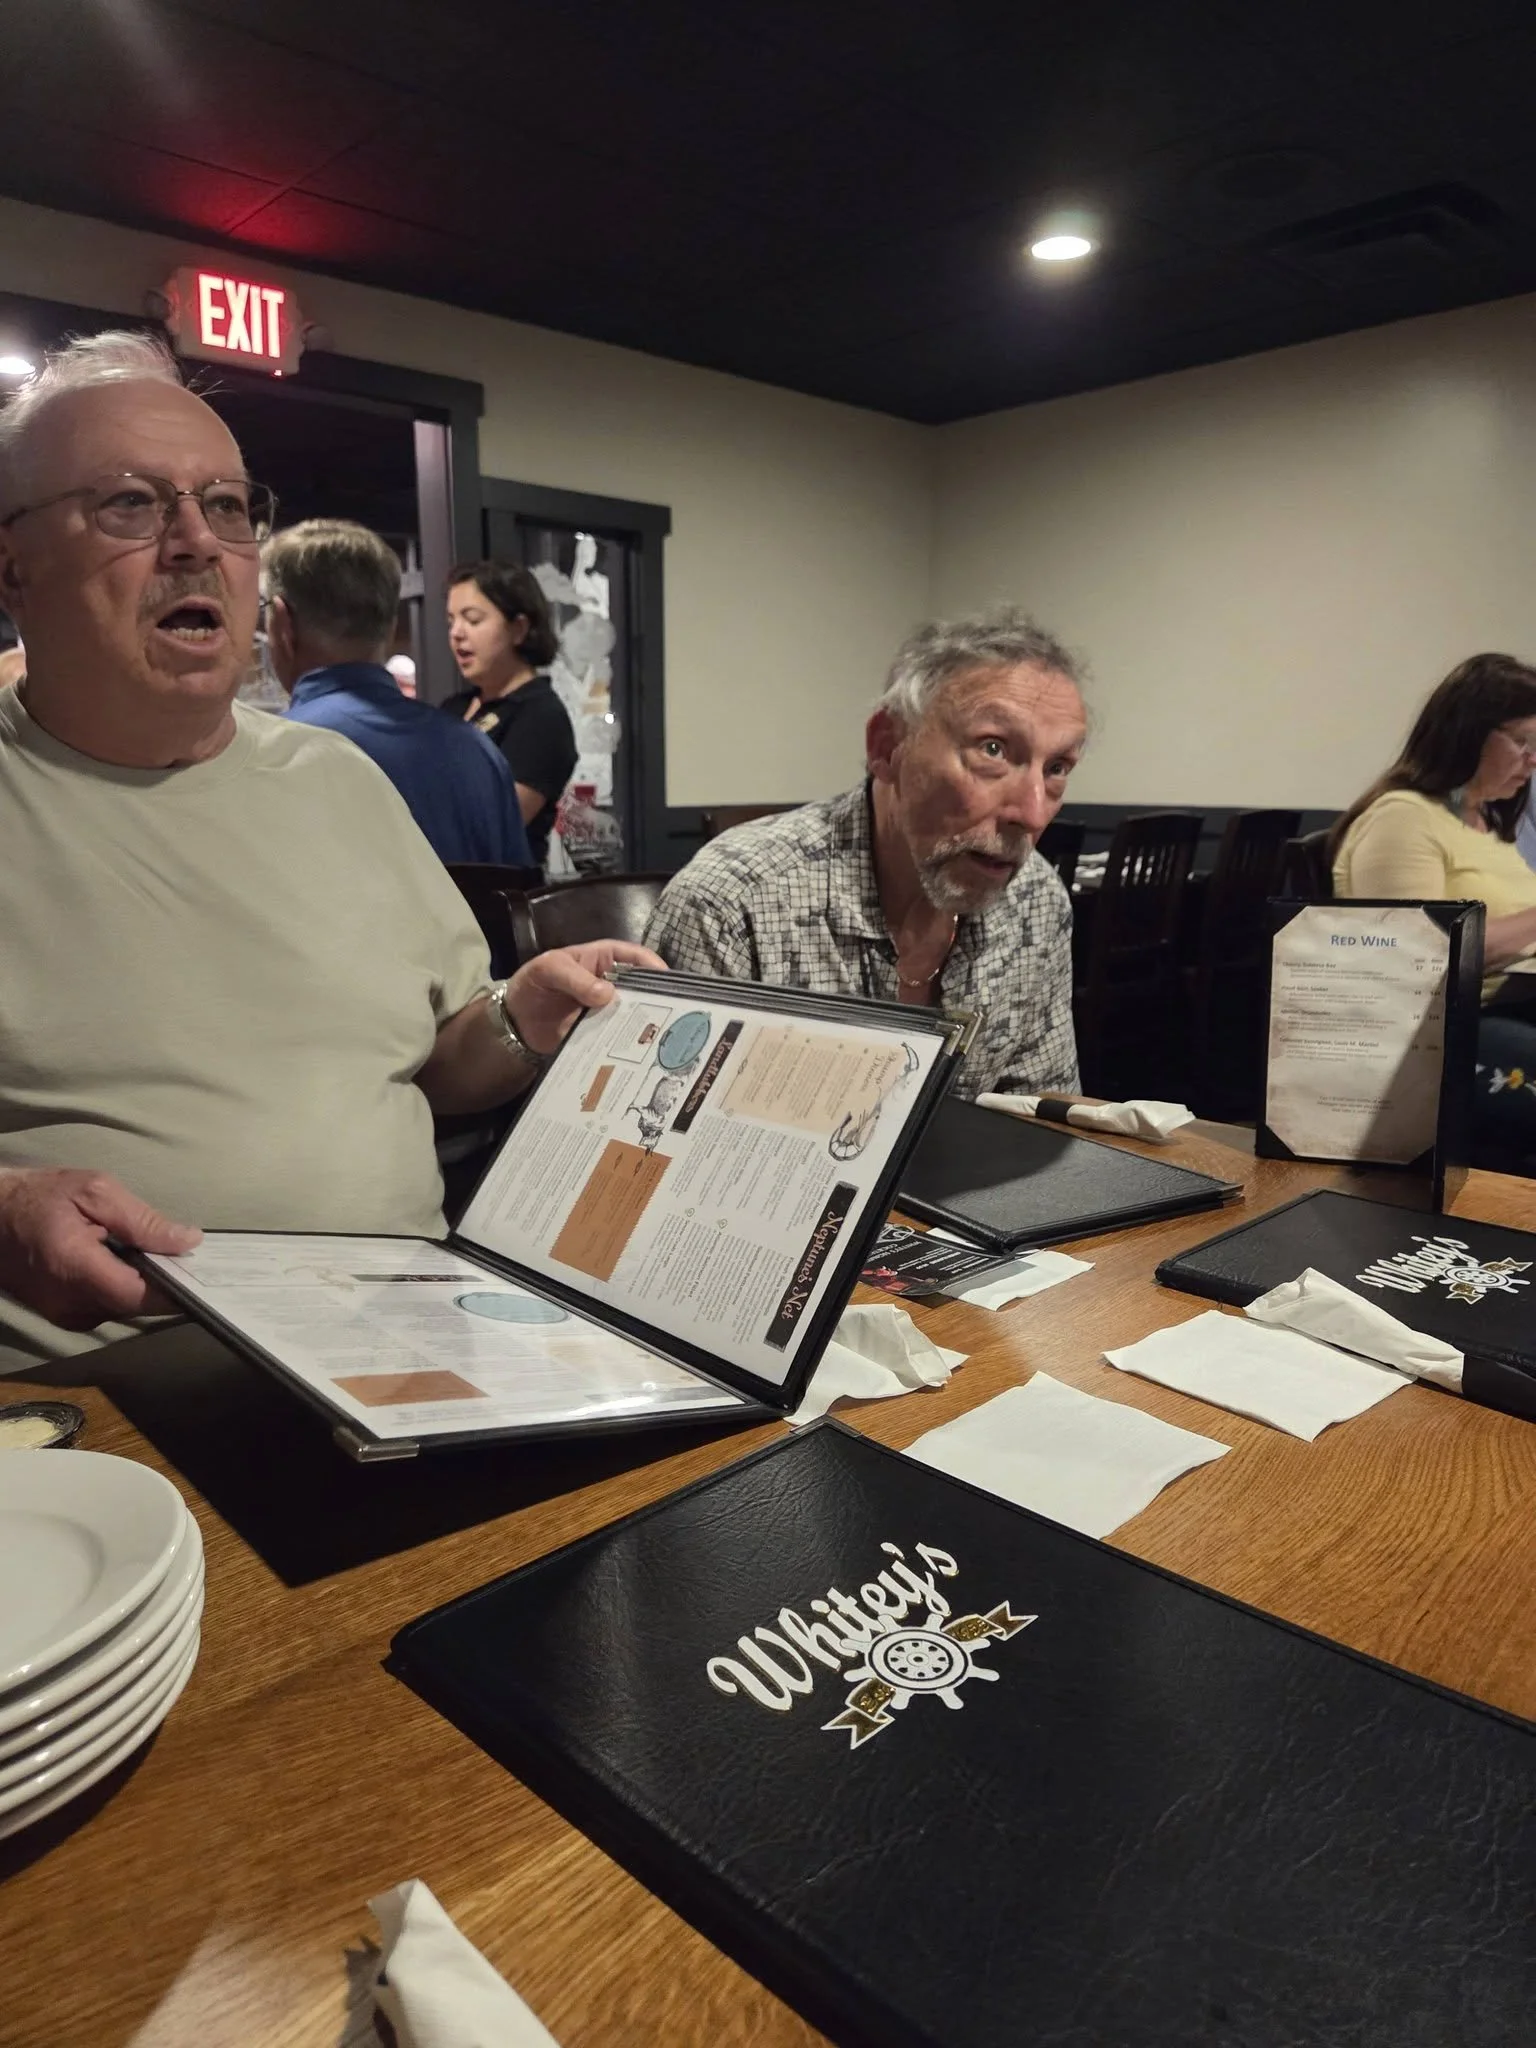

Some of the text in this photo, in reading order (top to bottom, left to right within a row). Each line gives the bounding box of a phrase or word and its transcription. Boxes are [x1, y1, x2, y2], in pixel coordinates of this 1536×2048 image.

[198, 273, 284, 358] EXIT
[1331, 935, 1397, 947] RED WINE
[797, 1211, 844, 1283] Neptune's
[1355, 1235, 1480, 1293] Whitey's
[781, 1286, 808, 1320] Net
[707, 1542, 959, 1711] Whitey's
